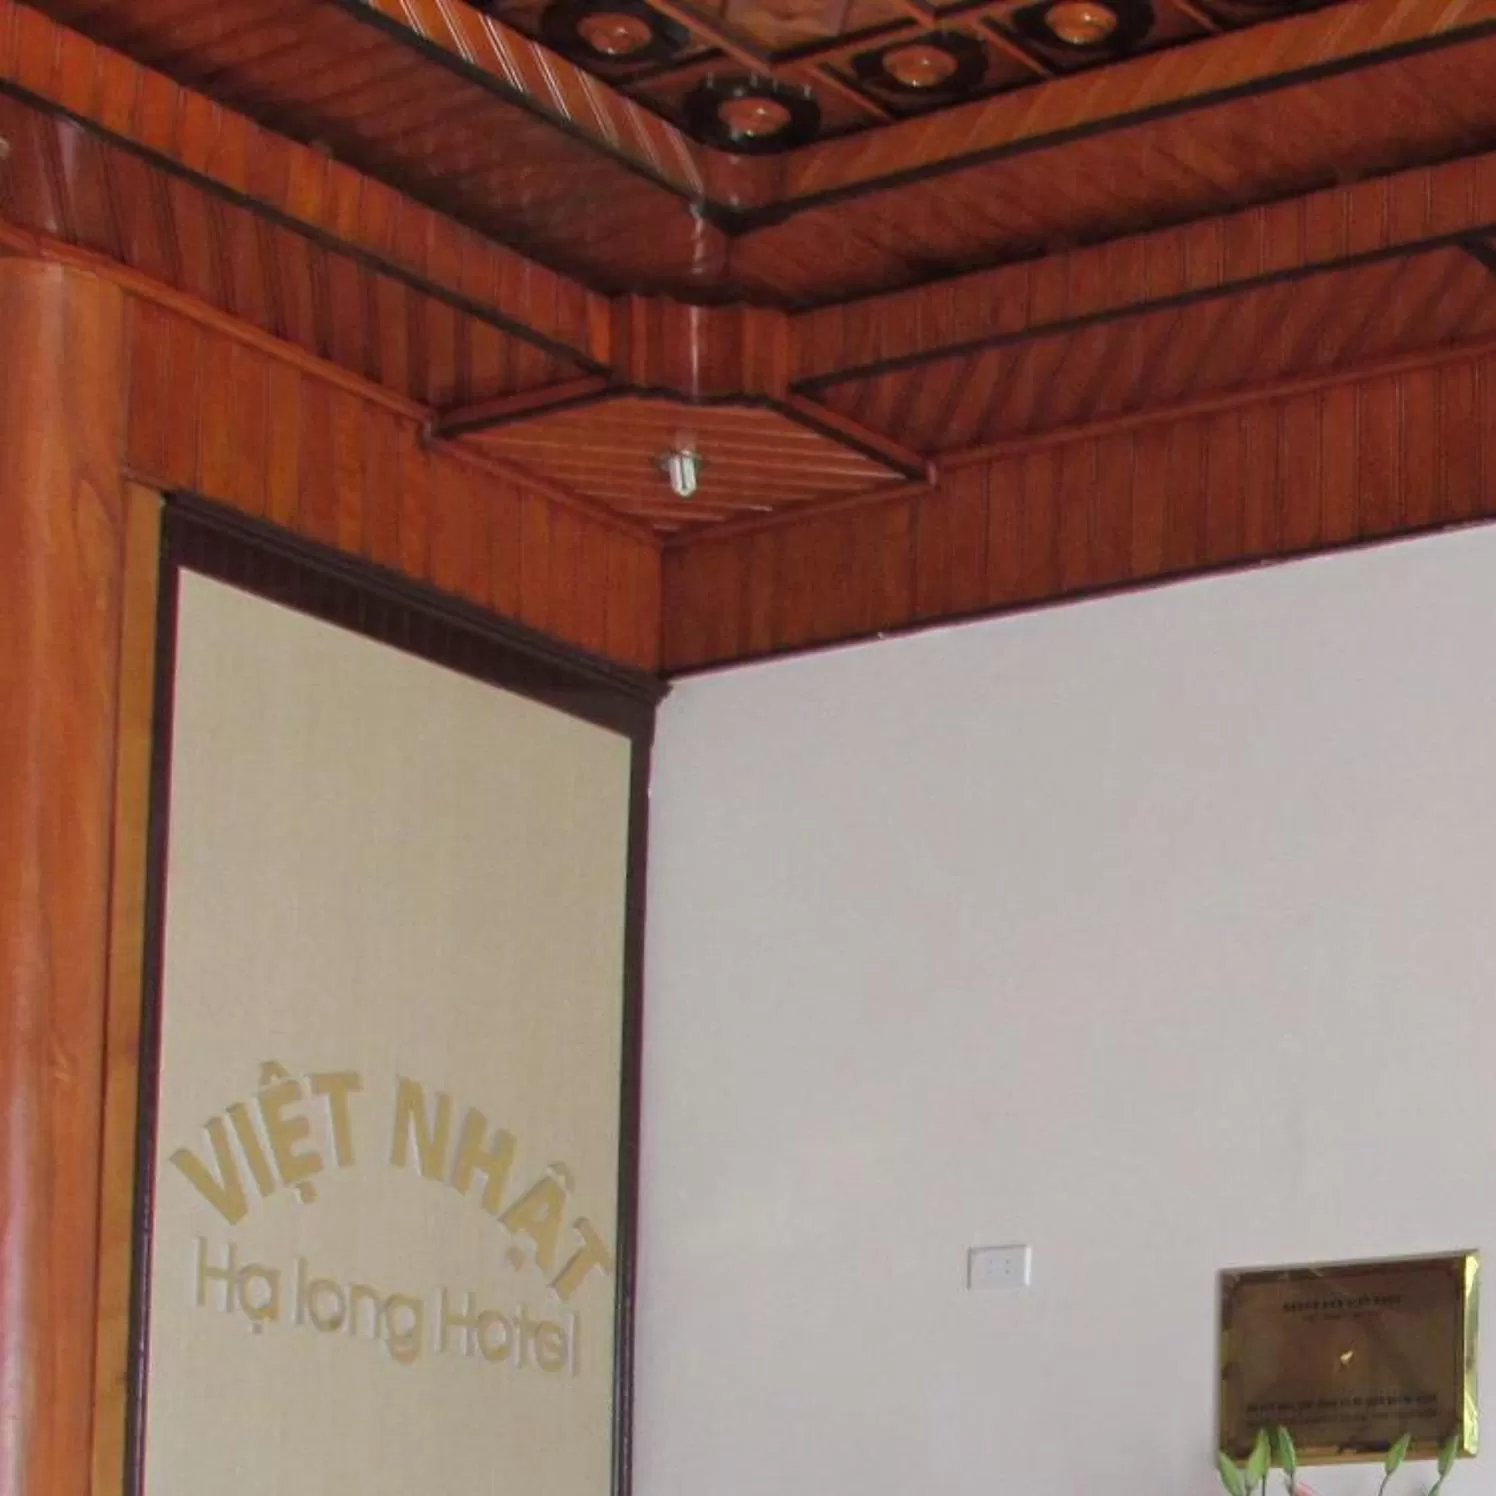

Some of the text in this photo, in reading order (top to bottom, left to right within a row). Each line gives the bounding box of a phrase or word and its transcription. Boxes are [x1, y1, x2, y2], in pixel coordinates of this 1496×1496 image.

[169, 1060, 612, 1302] VIỆT NHẬT
[295, 1257, 424, 1364] long
